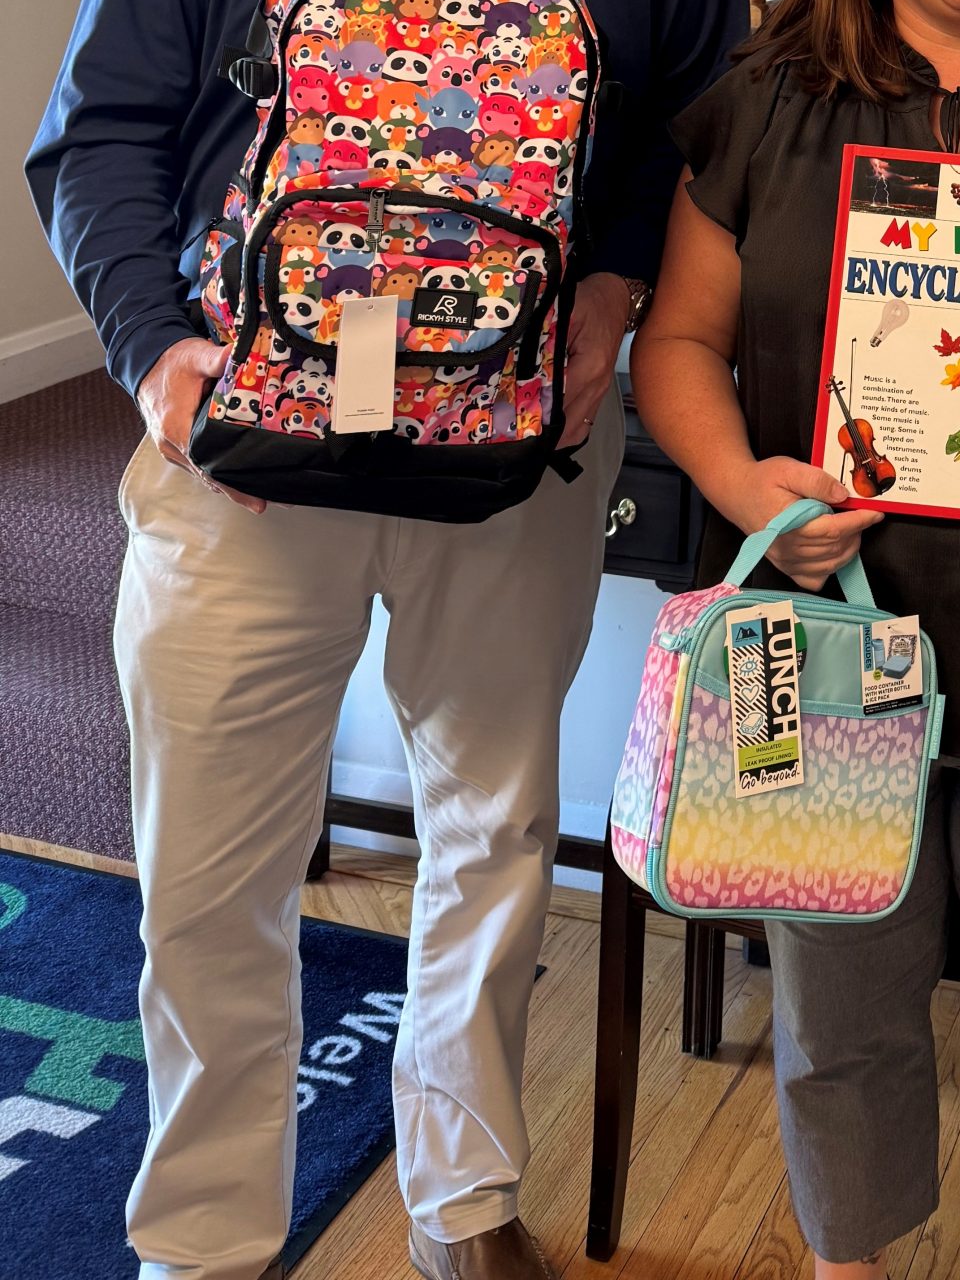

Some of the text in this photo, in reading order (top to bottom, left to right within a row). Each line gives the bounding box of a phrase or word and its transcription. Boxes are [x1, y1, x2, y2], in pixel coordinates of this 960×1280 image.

[880, 217, 938, 251] MY
[418, 314, 467, 324] RICKYH STYLE
[863, 386, 904, 394] combination
[887, 396, 906, 404] There
[886, 445, 928, 455] instruments,
[864, 626, 872, 669] INCLUDES
[767, 614, 798, 741] LUNCH
[879, 680, 904, 690] CONTAINER
[894, 684, 910, 692] BOTTLE
[756, 742, 782, 752] INSULATED
[741, 773, 756, 789] Go
